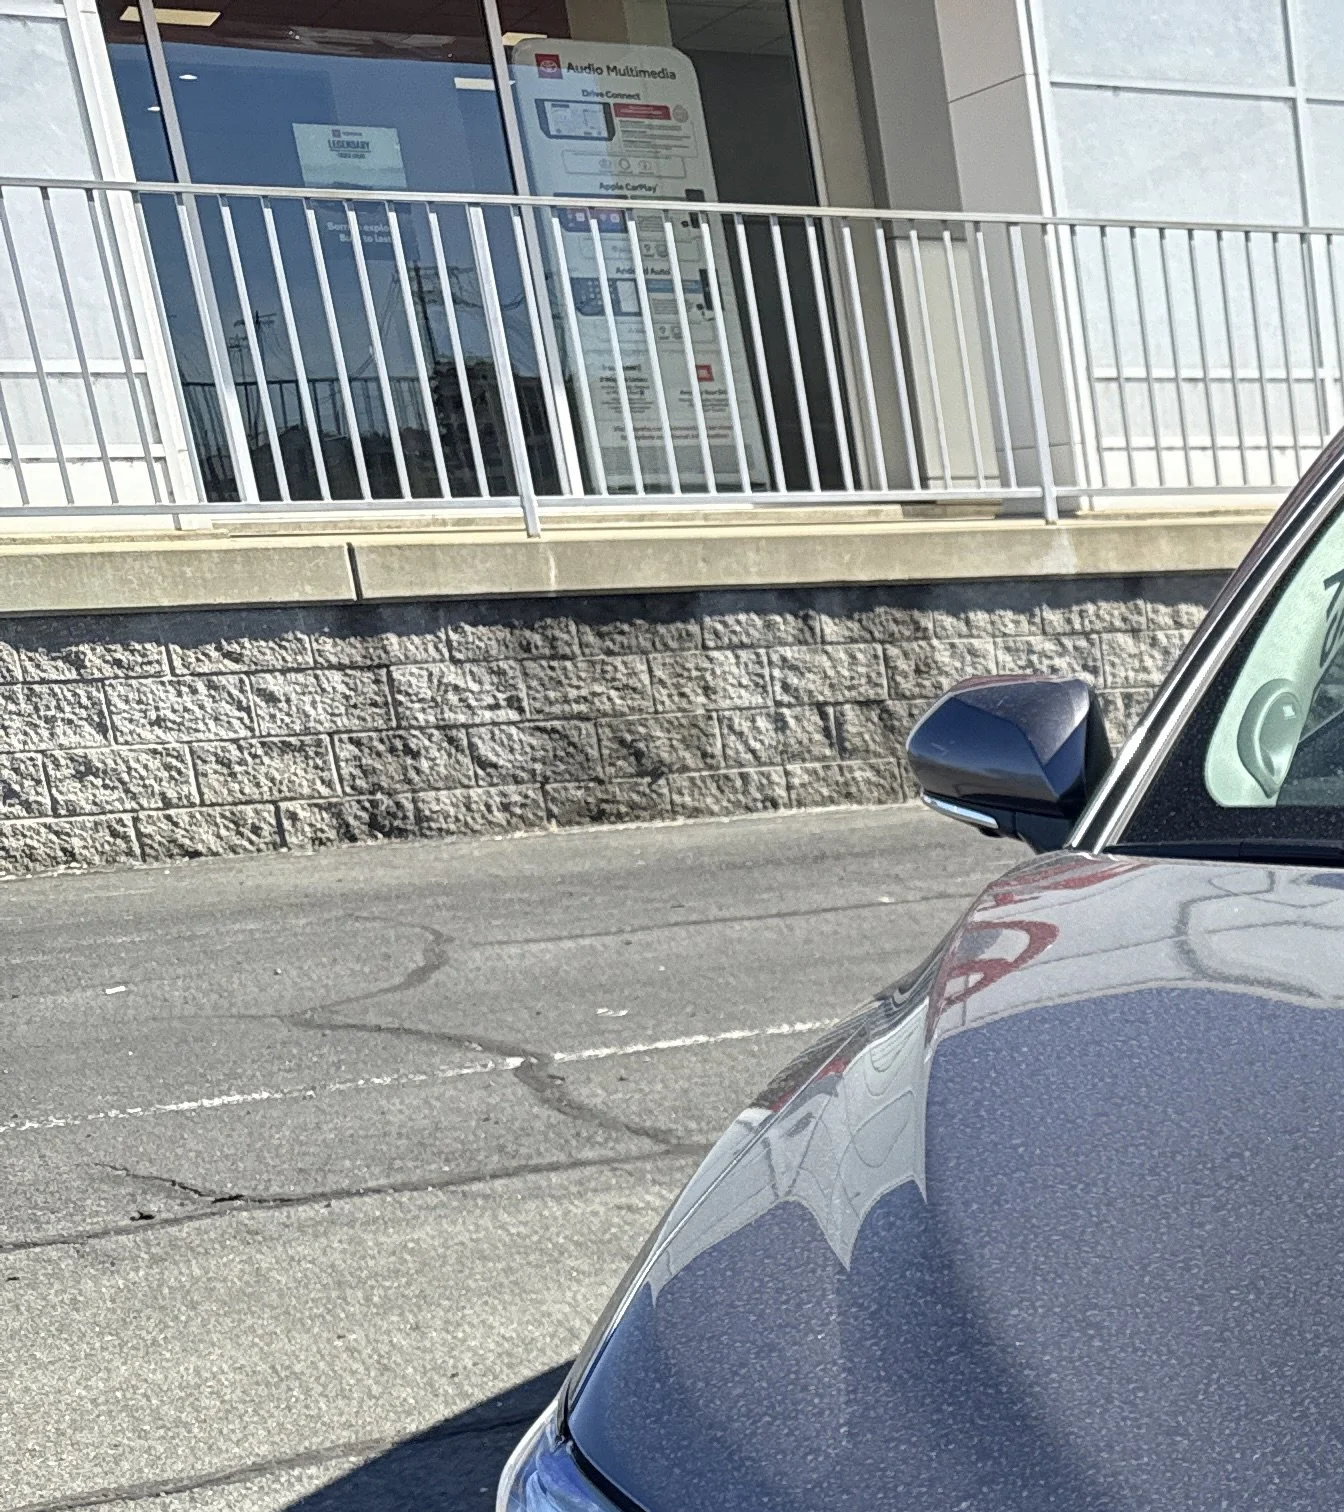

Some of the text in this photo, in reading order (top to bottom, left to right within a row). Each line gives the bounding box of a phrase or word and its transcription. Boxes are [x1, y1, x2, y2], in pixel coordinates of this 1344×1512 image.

[566, 61, 677, 80] Audio Multimedia
[581, 88, 641, 100] Drive Connect
[600, 182, 624, 192] Apple
